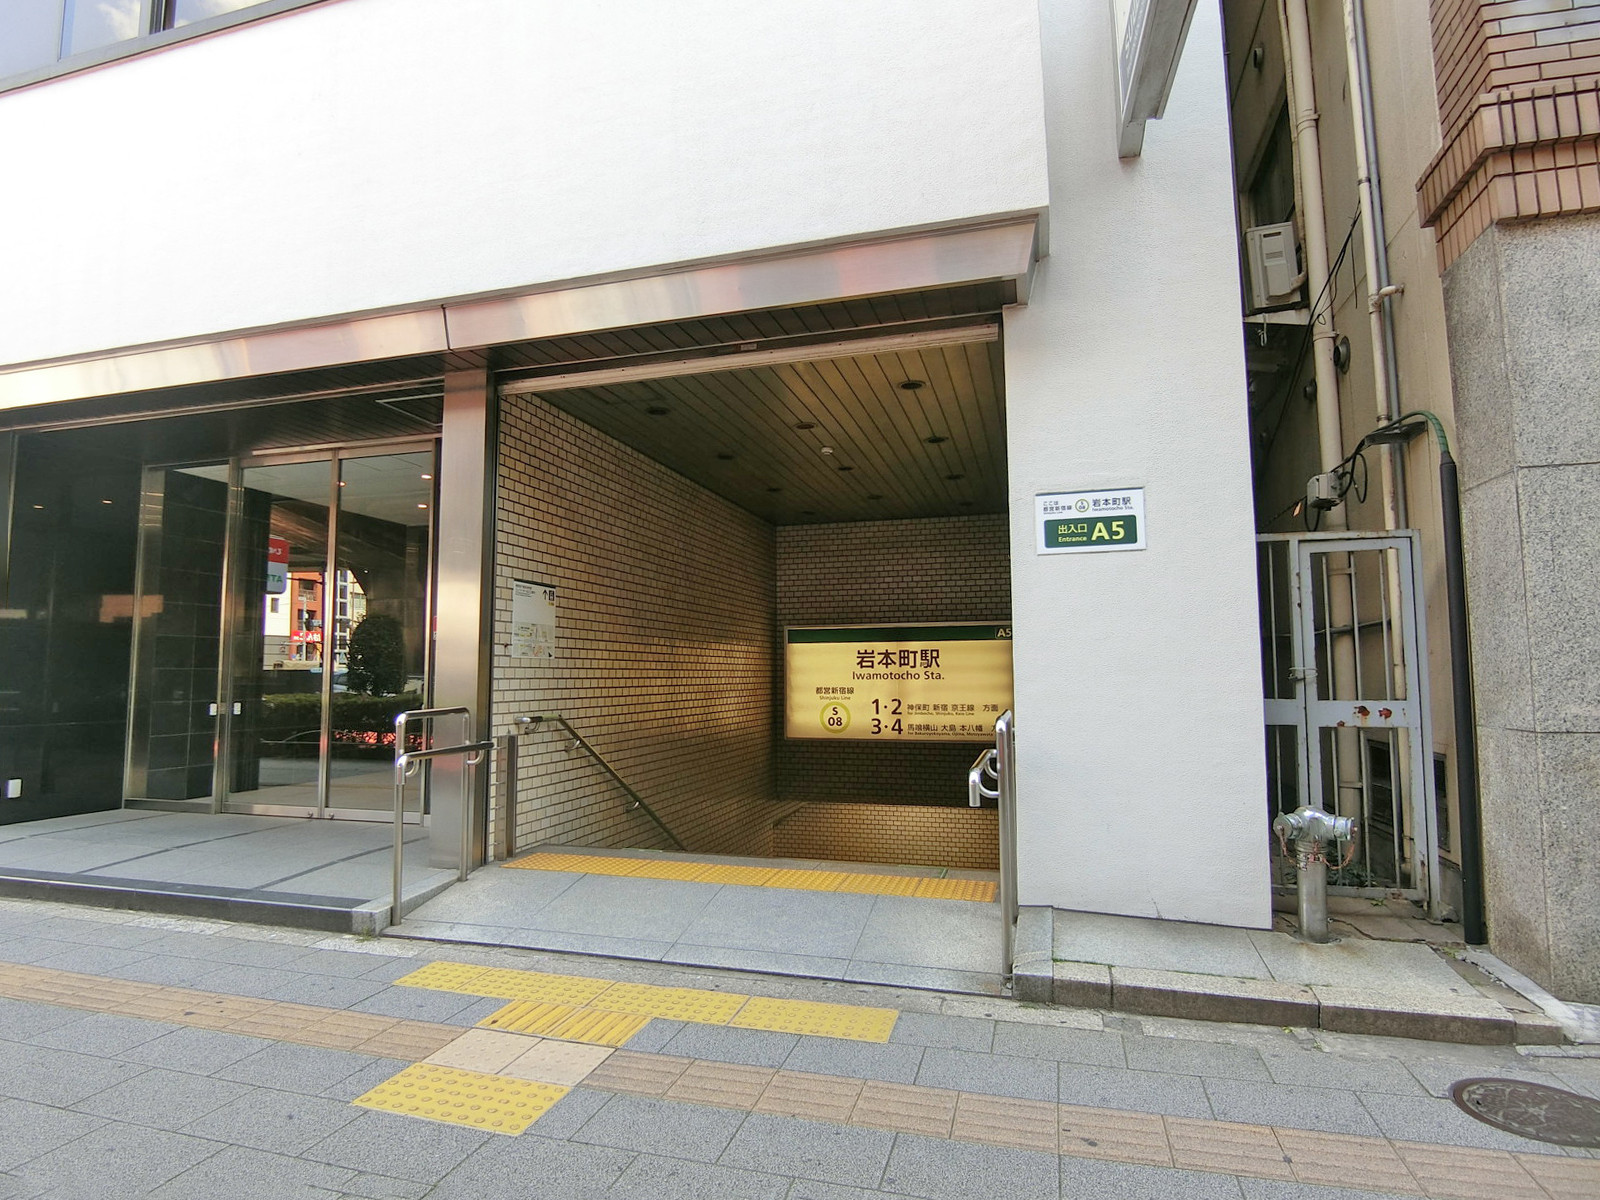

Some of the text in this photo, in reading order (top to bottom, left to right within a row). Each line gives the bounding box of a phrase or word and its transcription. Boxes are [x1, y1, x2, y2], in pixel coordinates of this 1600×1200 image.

[1092, 496, 1131, 507] 岩本町駅
[1058, 523, 1087, 534] 出入口
[1091, 521, 1125, 541] A5
[997, 628, 1011, 637] A5
[856, 649, 940, 669] 岩本町駅
[852, 670, 945, 680] Iwamotocho Sta.
[816, 686, 855, 695] 都営新宿線
[832, 706, 839, 716] S
[907, 703, 999, 712] 神保町 新宿 京王線 方面
[827, 716, 843, 727] 08
[941, 723, 957, 732] 大島
[959, 724, 983, 732] 本八幡
